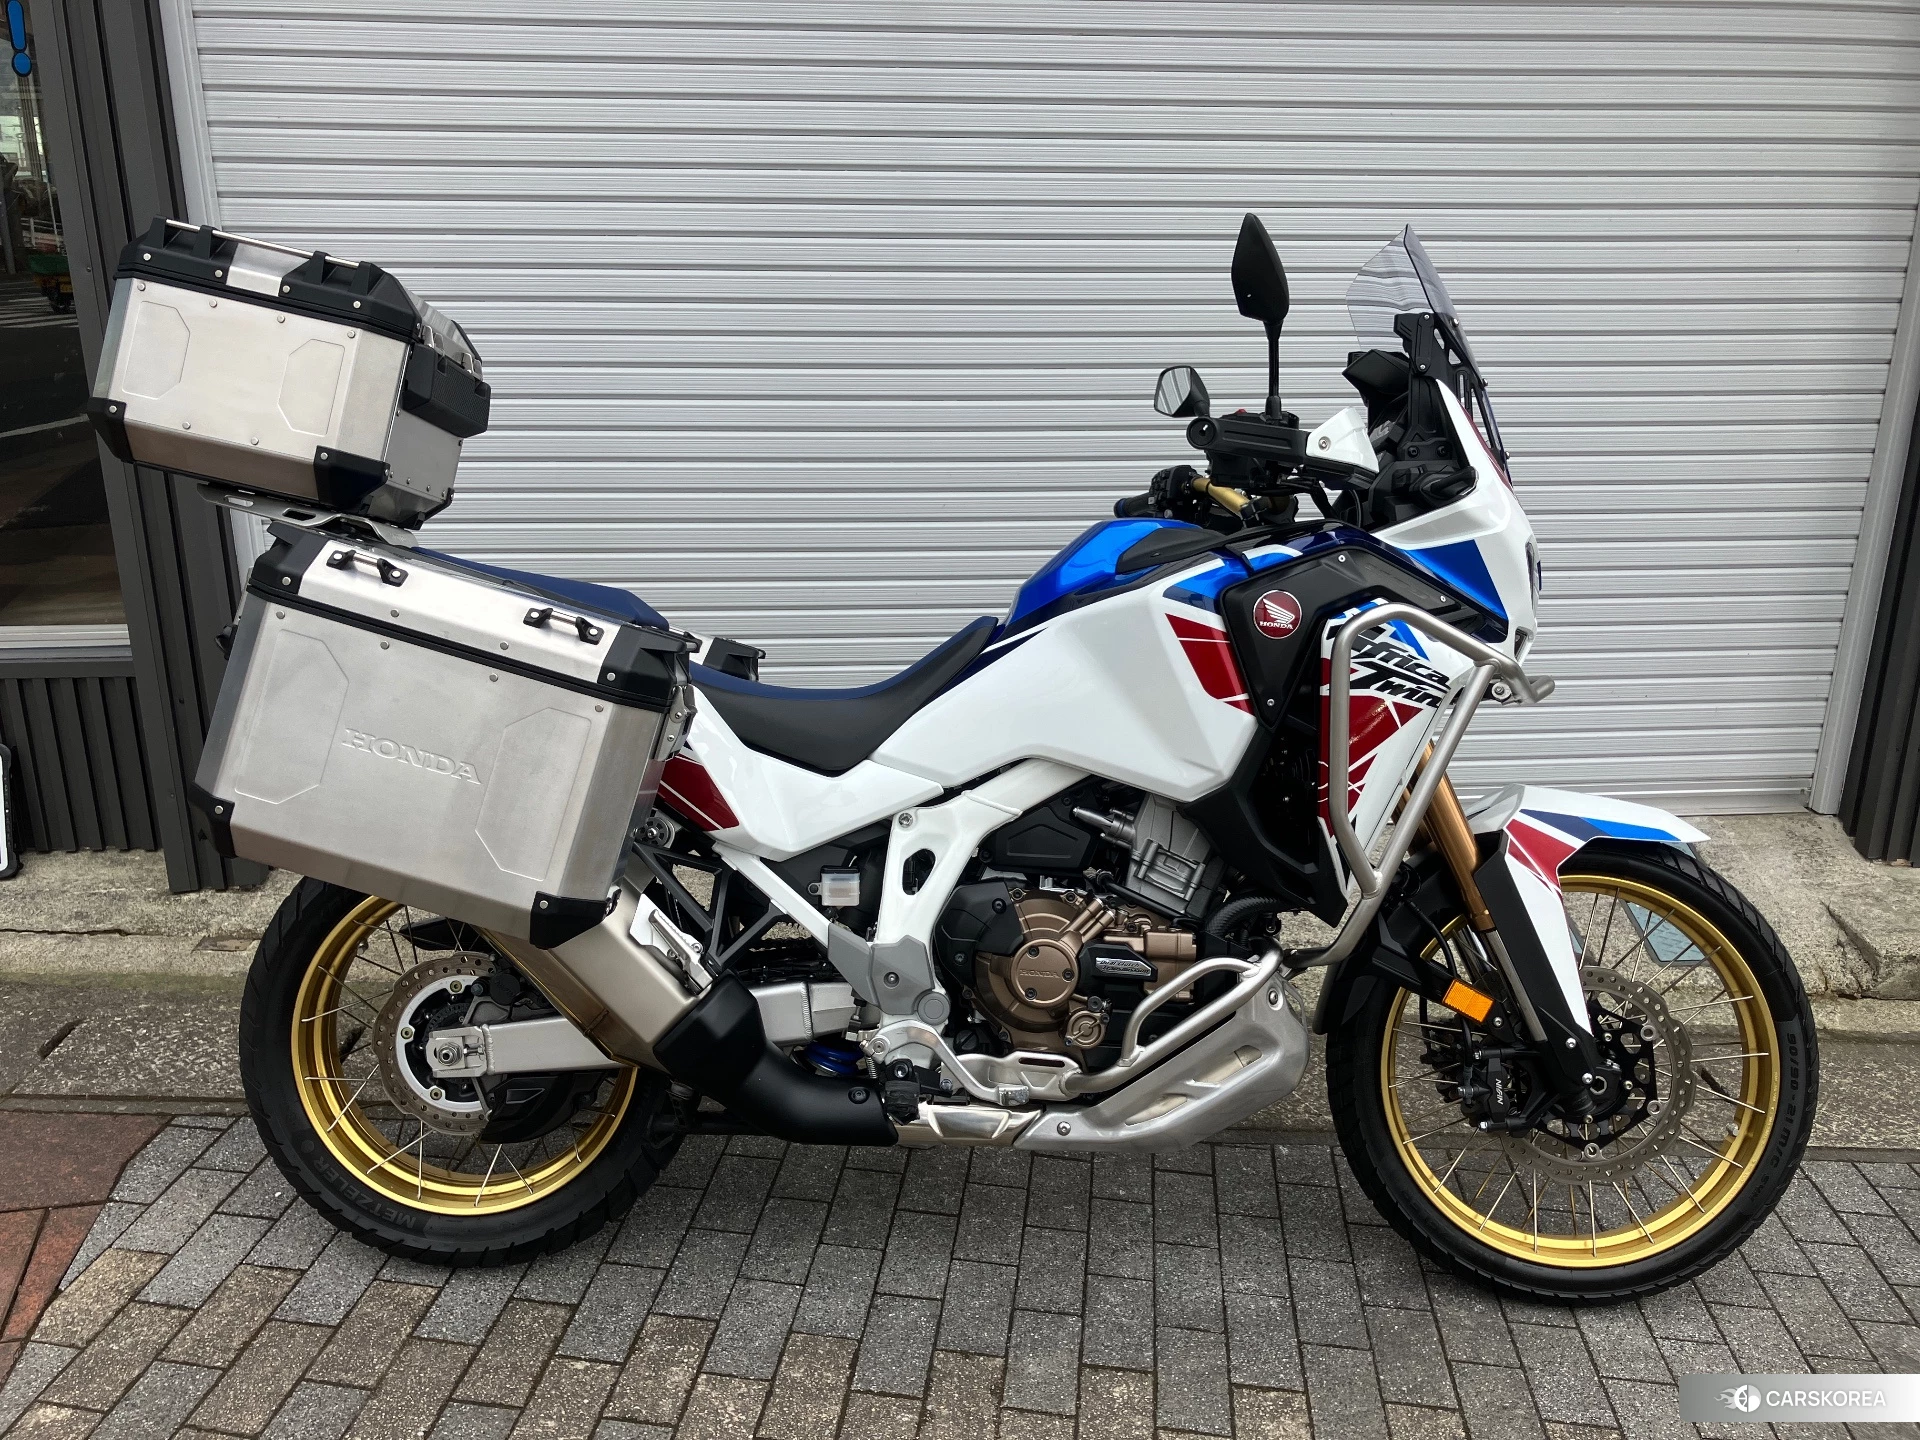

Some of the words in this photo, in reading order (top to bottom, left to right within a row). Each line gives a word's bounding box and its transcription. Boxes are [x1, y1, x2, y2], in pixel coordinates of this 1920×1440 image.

[1259, 620, 1294, 630] HONDA
[1349, 661, 1449, 709] Twin
[341, 728, 482, 785] HONDA
[1019, 968, 1061, 979] HONDA
[313, 1155, 417, 1229] METZELER
